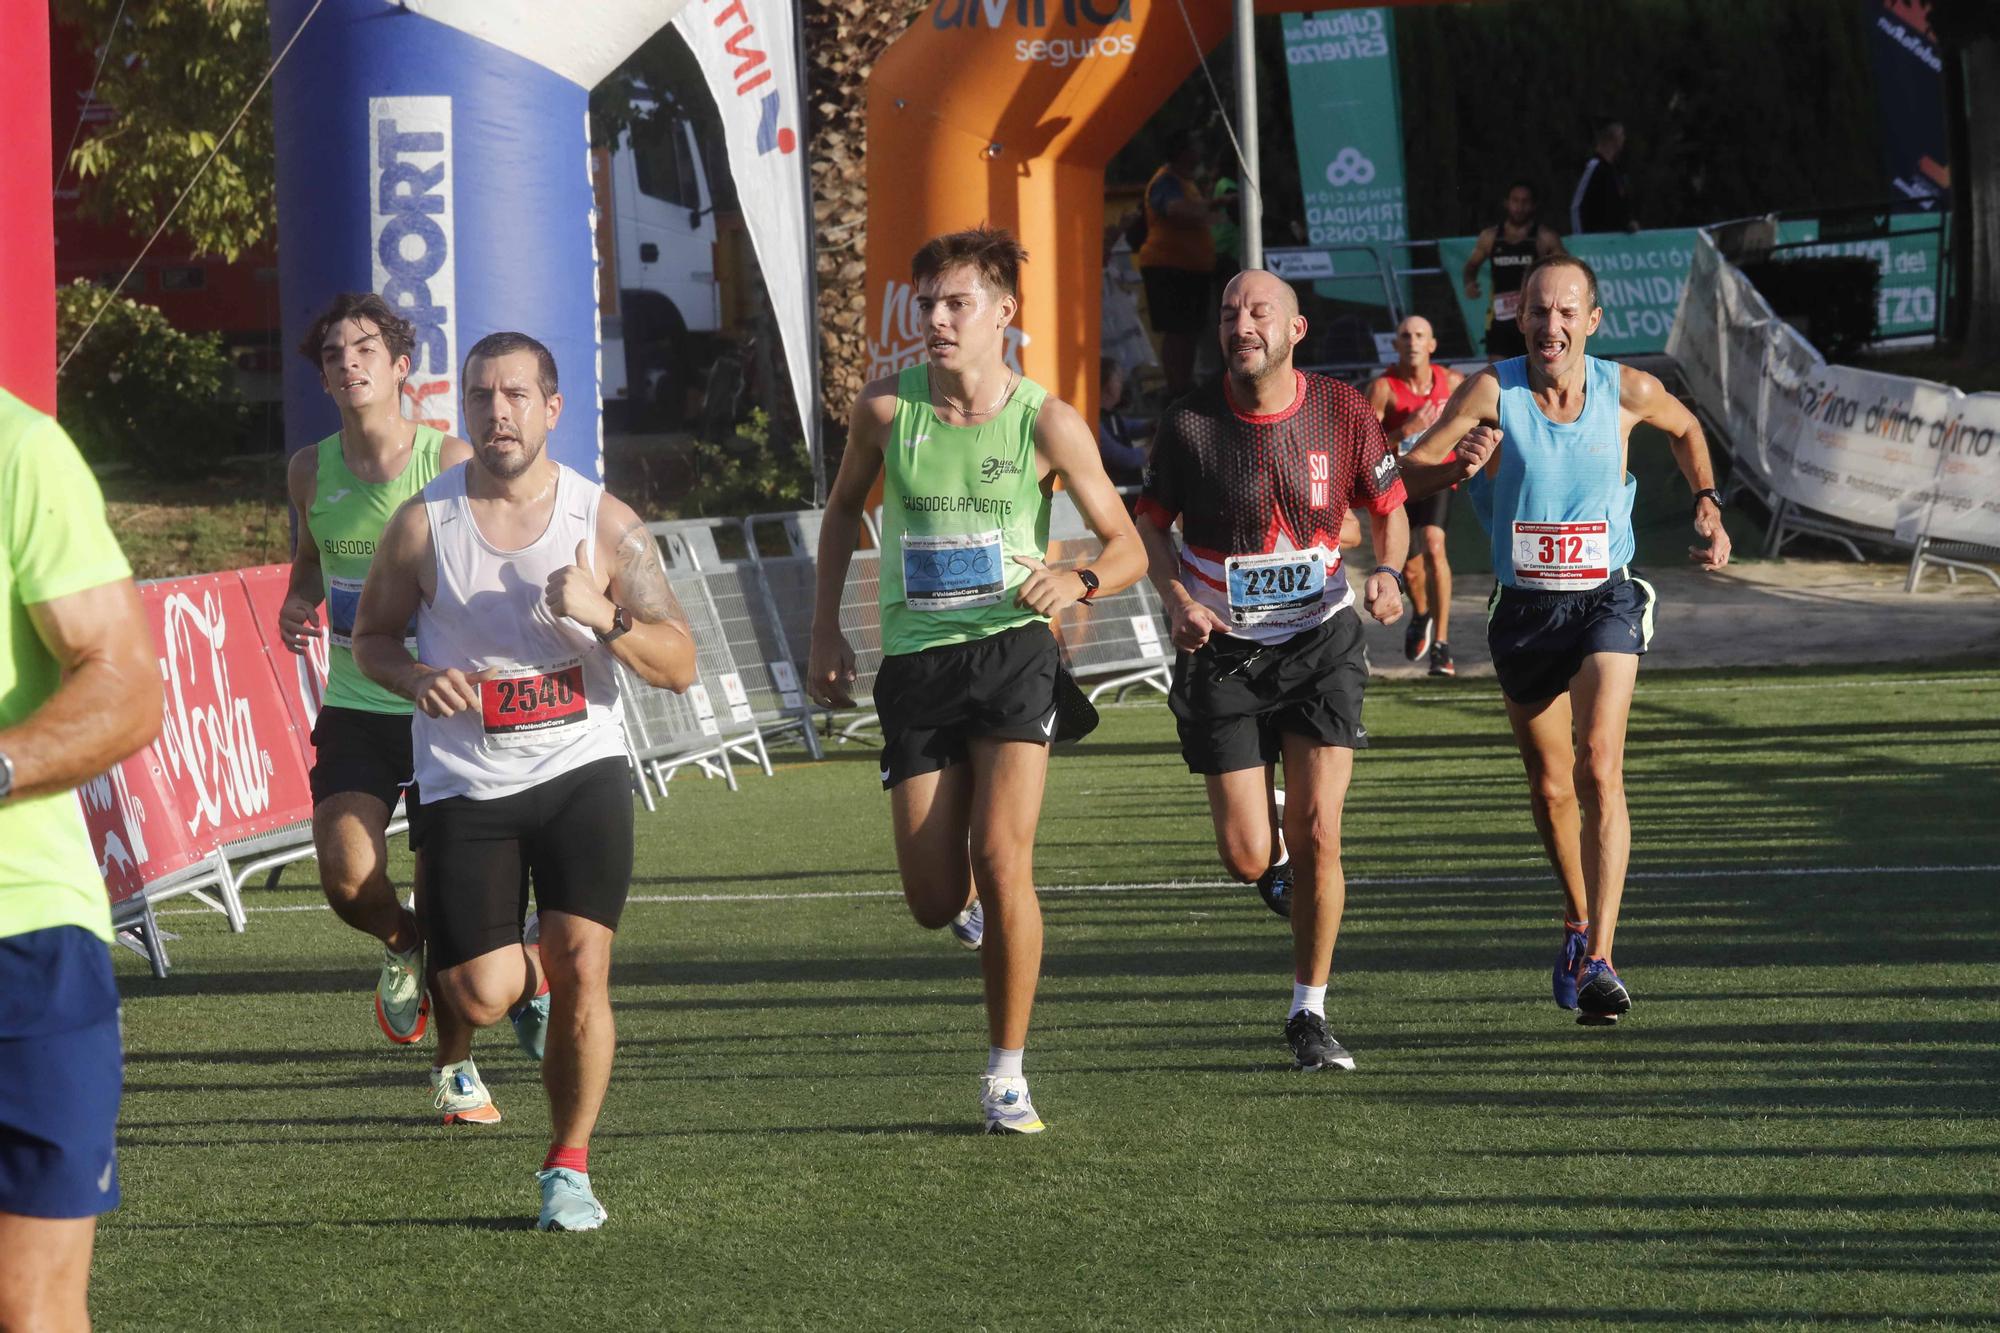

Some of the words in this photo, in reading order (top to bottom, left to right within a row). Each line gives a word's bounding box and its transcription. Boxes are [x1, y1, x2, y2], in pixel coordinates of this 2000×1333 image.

[1015, 34, 1137, 67] seguros
[1582, 247, 1693, 273] UNDACIÓN
[1598, 275, 1685, 307] RINIDA
[1598, 308, 1675, 340] ALFON
[1310, 454, 1328, 480] SO
[902, 496, 1013, 515] SUSODELAFUENTE
[1312, 483, 1323, 507] M
[907, 549, 993, 580] 2666
[1538, 536, 1583, 564] 312
[1243, 564, 1312, 596] 2202
[497, 674, 574, 714] 2540
